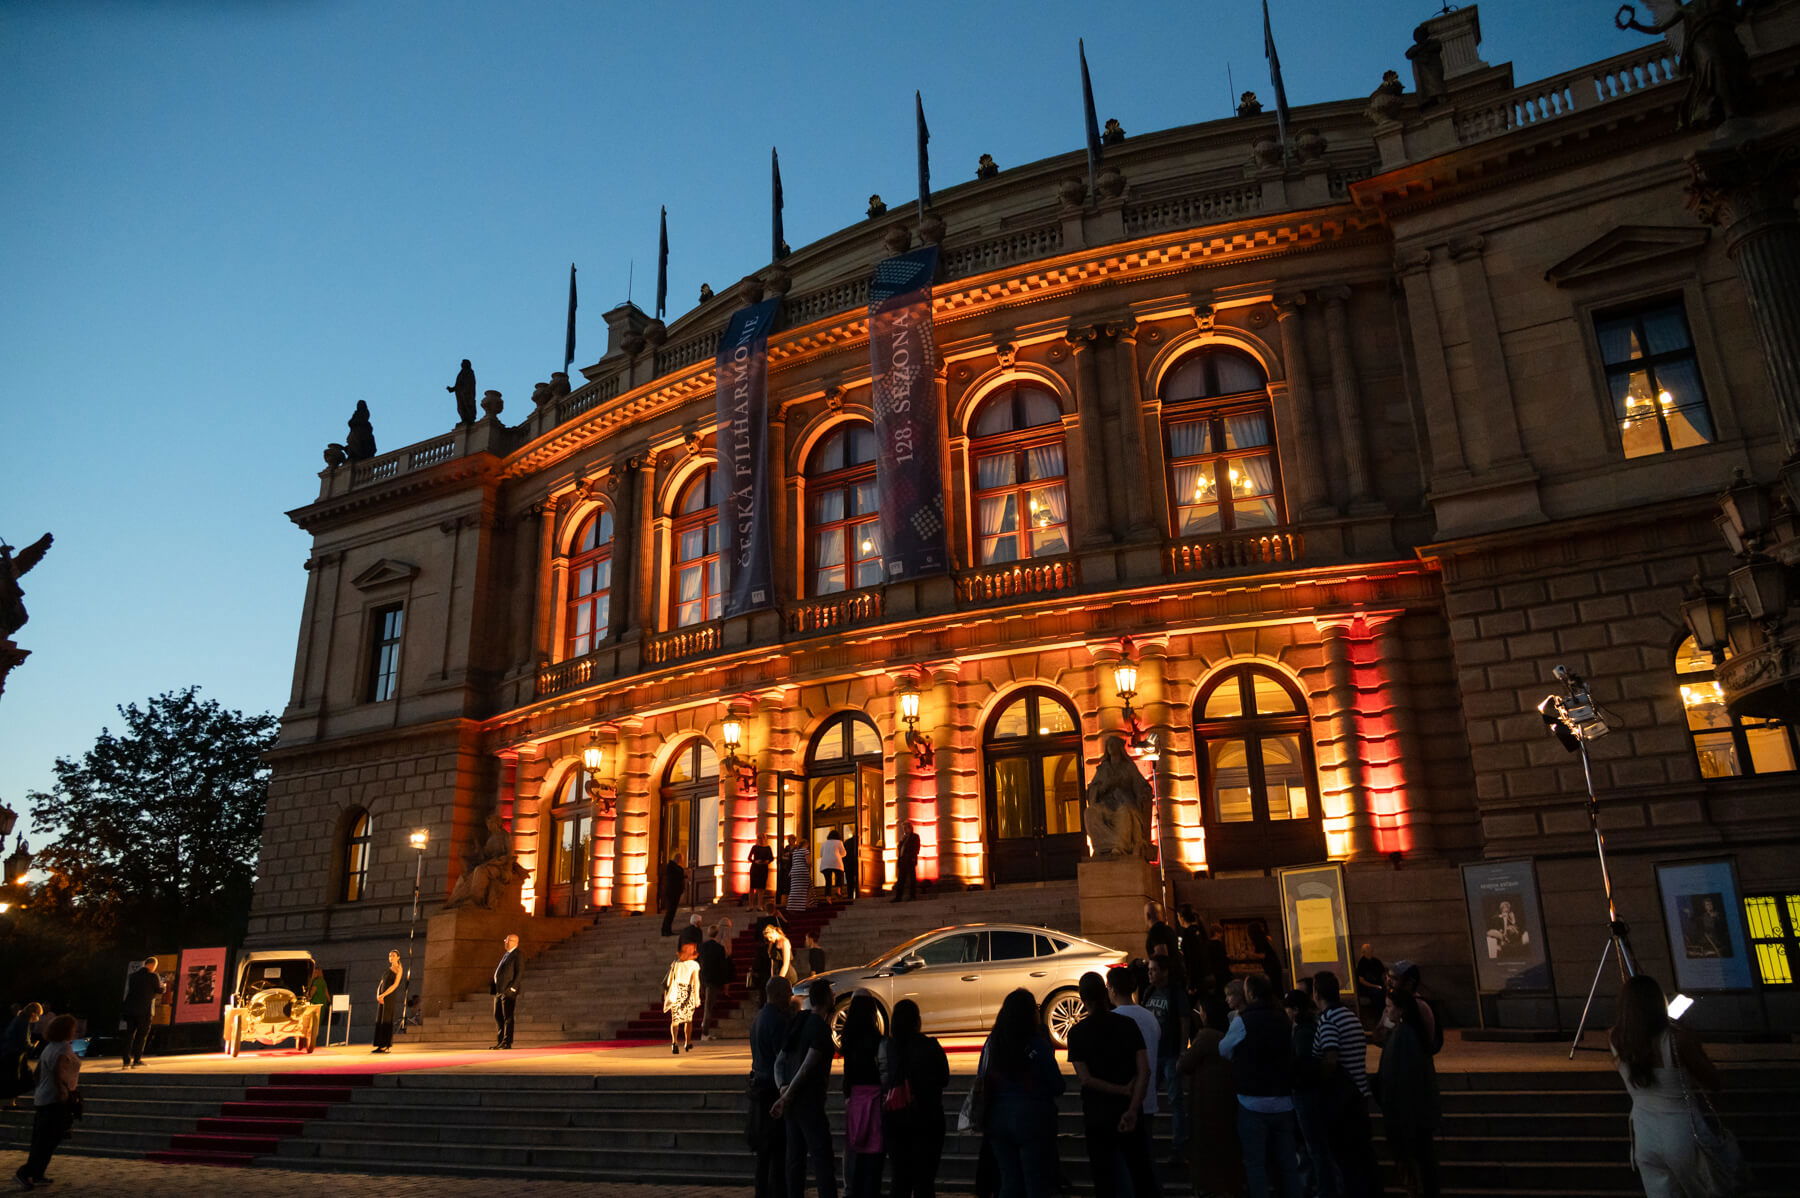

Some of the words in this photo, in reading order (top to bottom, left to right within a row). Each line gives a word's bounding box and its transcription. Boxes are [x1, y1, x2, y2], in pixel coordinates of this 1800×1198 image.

[733, 314, 760, 479] FILHARMONIE
[892, 311, 911, 414] SEZONA
[895, 419, 914, 465] 128.
[735, 484, 754, 568] ČESKÁ
